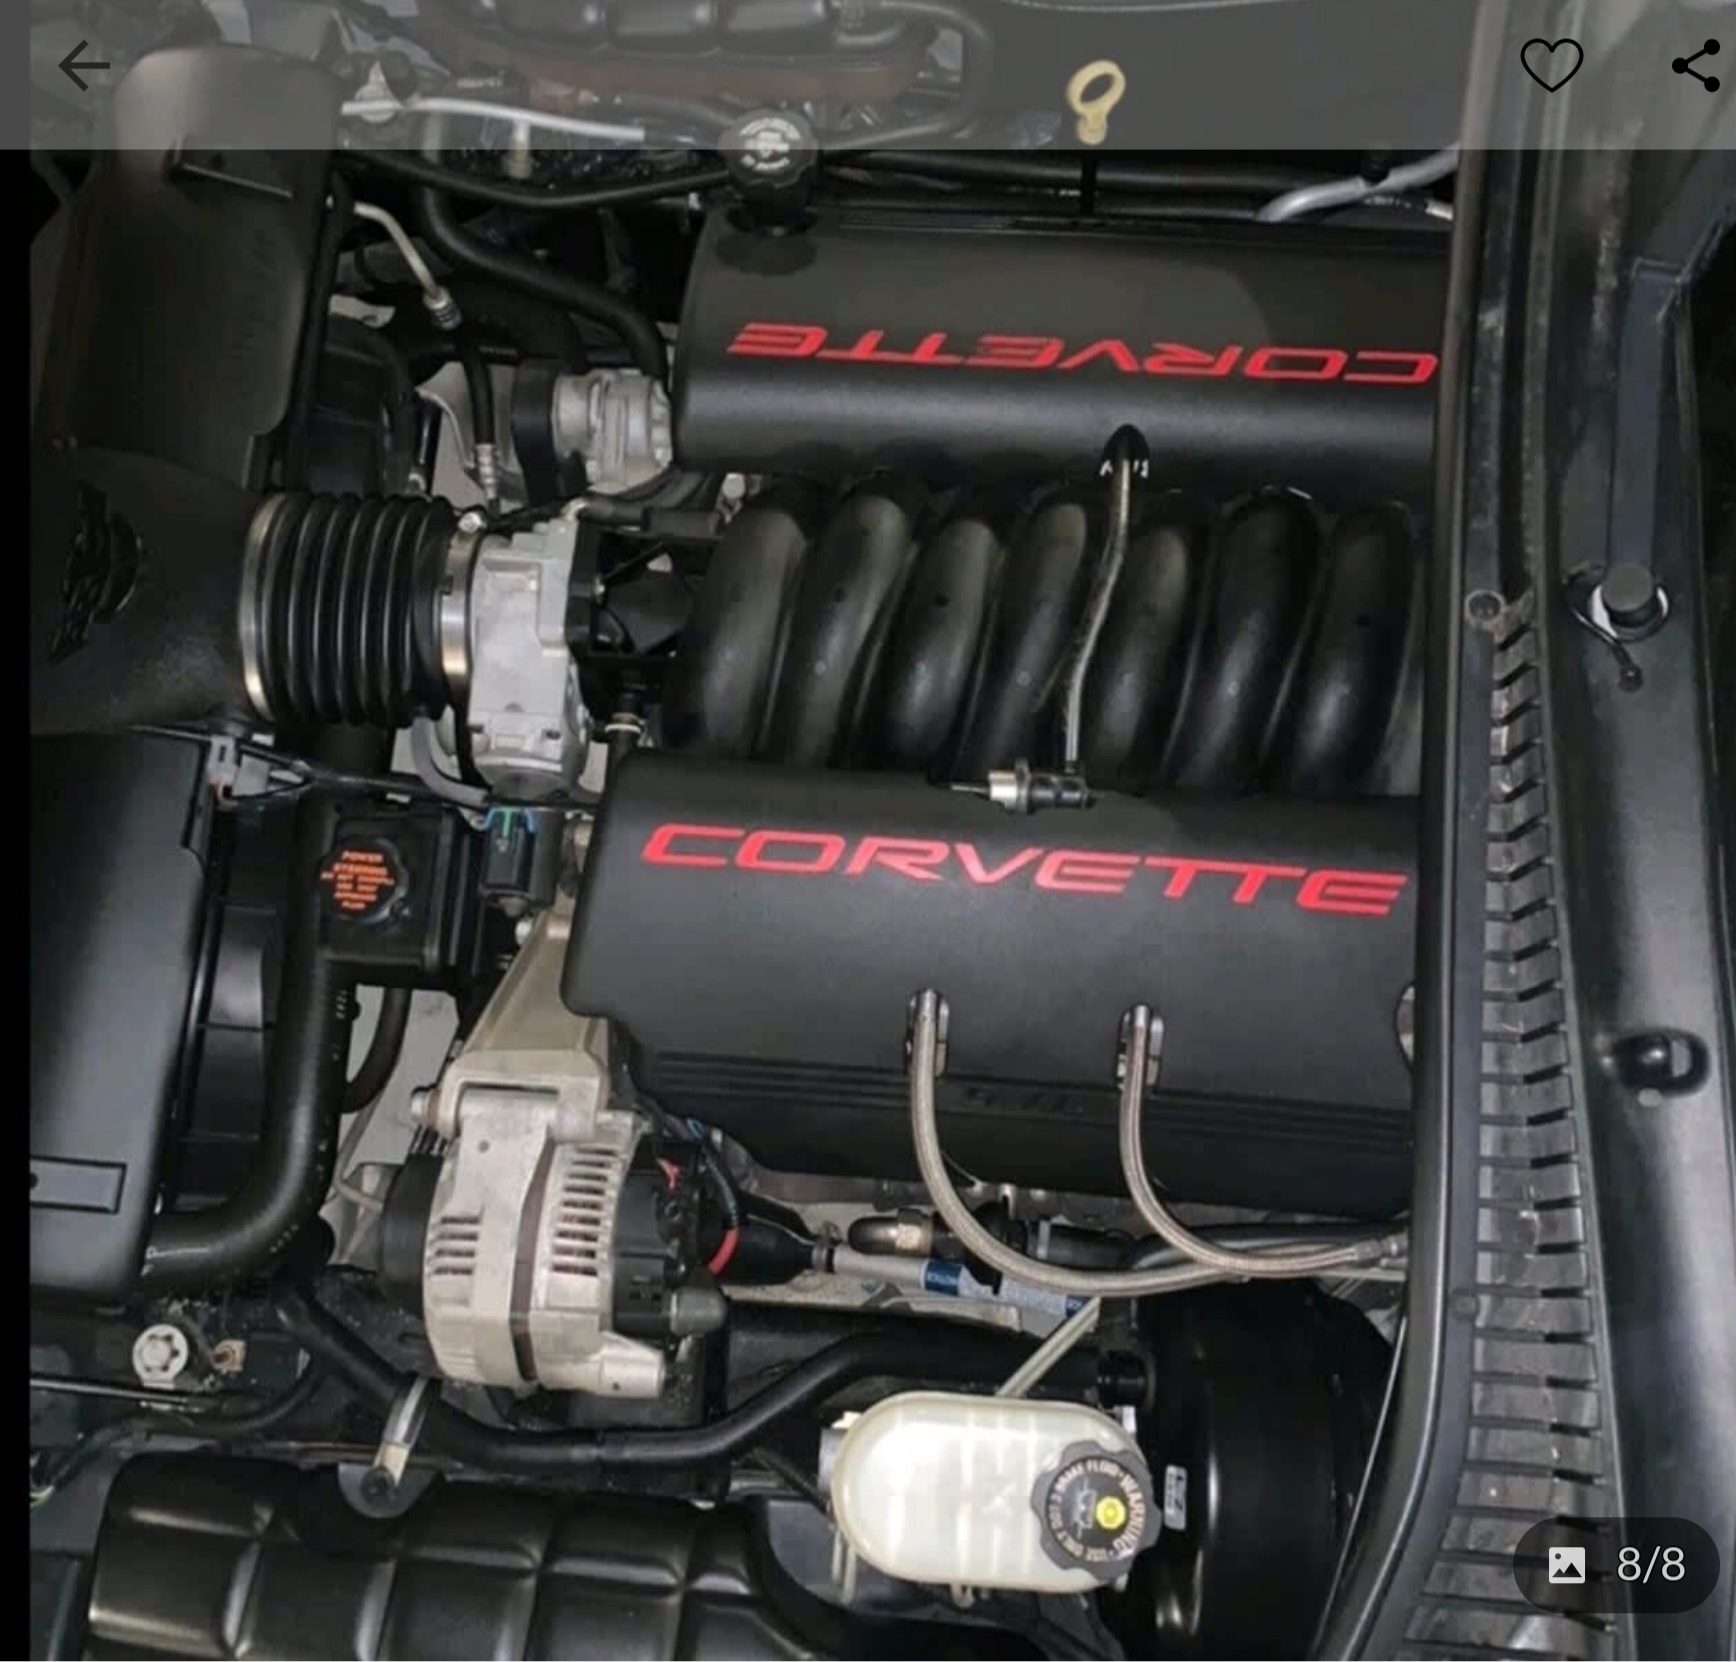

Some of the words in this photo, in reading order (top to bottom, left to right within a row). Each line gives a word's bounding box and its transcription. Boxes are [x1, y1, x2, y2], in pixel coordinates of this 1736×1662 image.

[727, 321, 1438, 385] CORVETTE
[641, 823, 1407, 917] CORVETTE
[1112, 1474, 1145, 1552] WARNING
